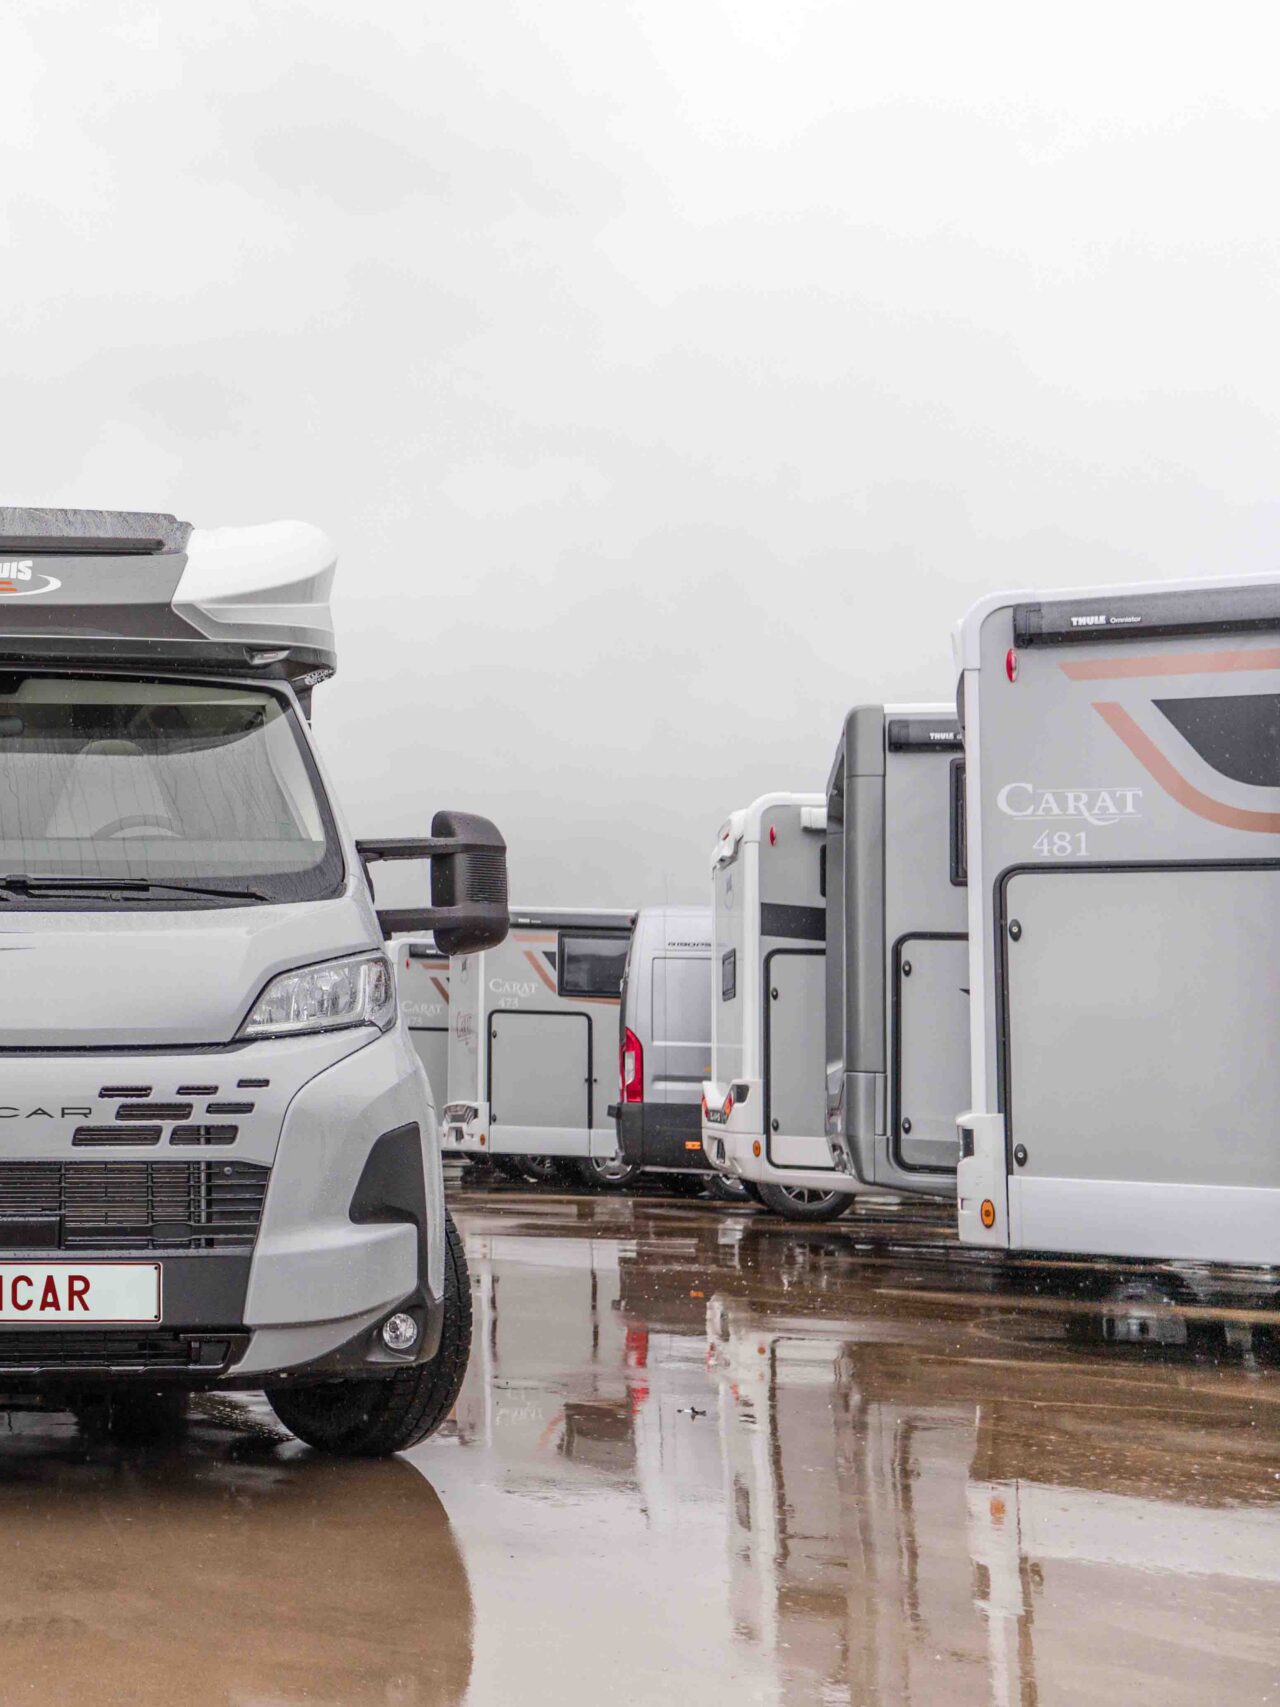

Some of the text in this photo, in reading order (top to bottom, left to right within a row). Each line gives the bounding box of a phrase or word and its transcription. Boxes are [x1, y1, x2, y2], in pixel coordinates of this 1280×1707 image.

[1070, 615, 1142, 626] THULE Omnistor
[929, 732, 955, 740] THULE
[1032, 829, 1090, 857] 481
